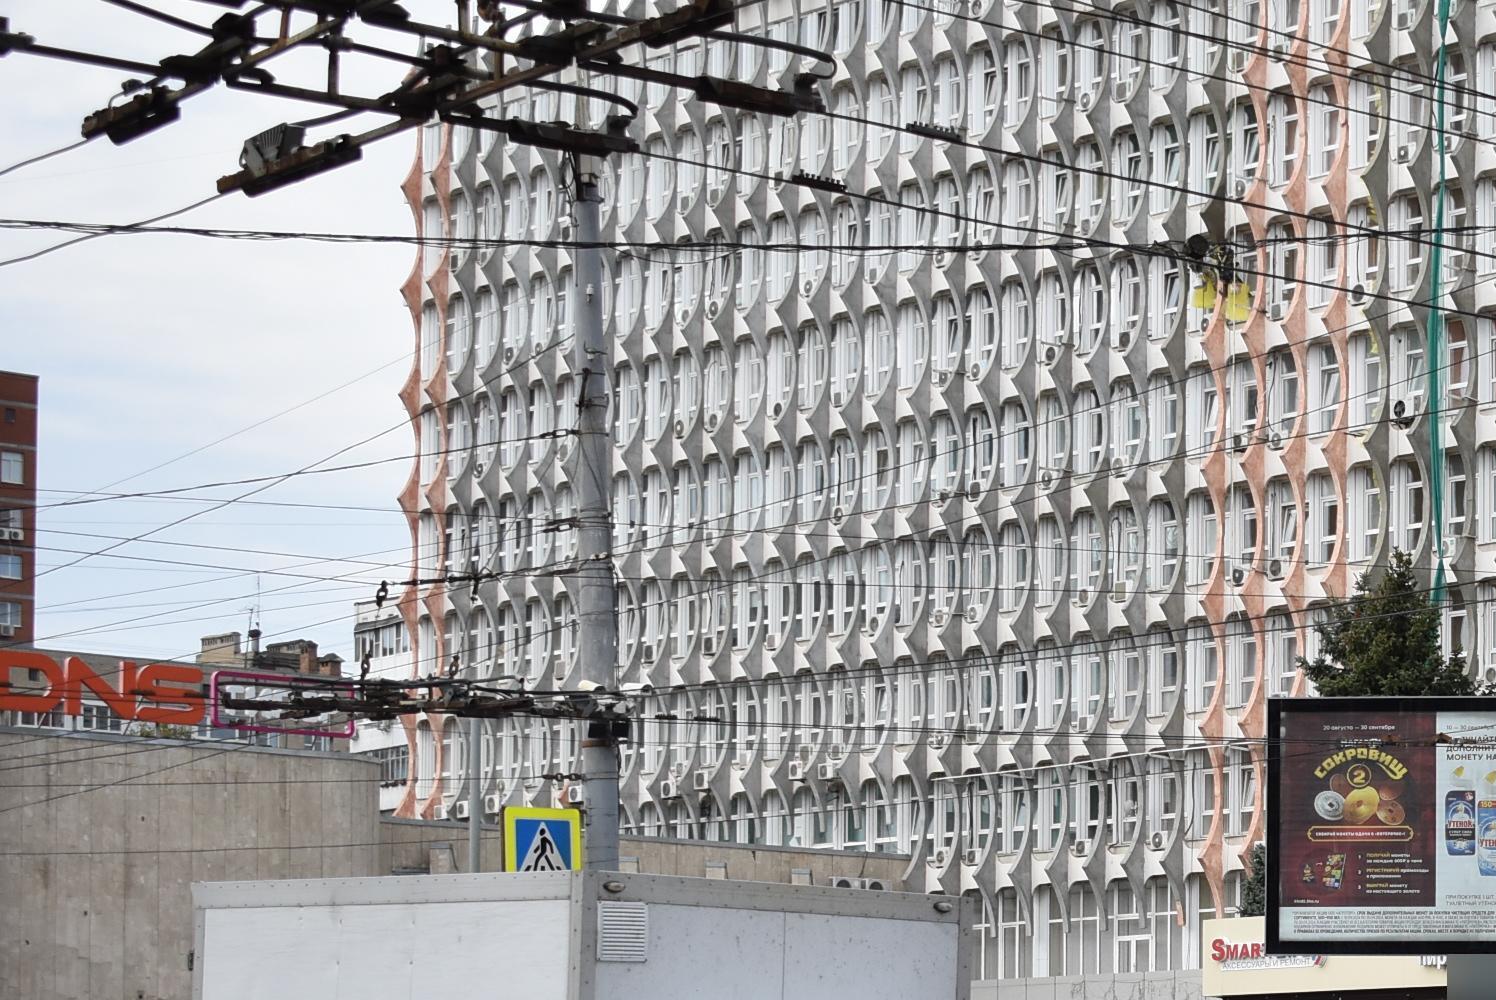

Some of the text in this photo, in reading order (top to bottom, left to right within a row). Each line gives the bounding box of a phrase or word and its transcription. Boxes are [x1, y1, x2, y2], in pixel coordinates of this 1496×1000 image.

[0, 650, 206, 726] DNS
[1313, 747, 1409, 780] СОКРОВИЩ
[1446, 753, 1484, 761] МОНЕТУ
[1353, 770, 1366, 784] 2
[1211, 938, 1265, 962] SMAR
[1222, 957, 1311, 969] АКСЕССУАРЫ И РЕМОНТ
